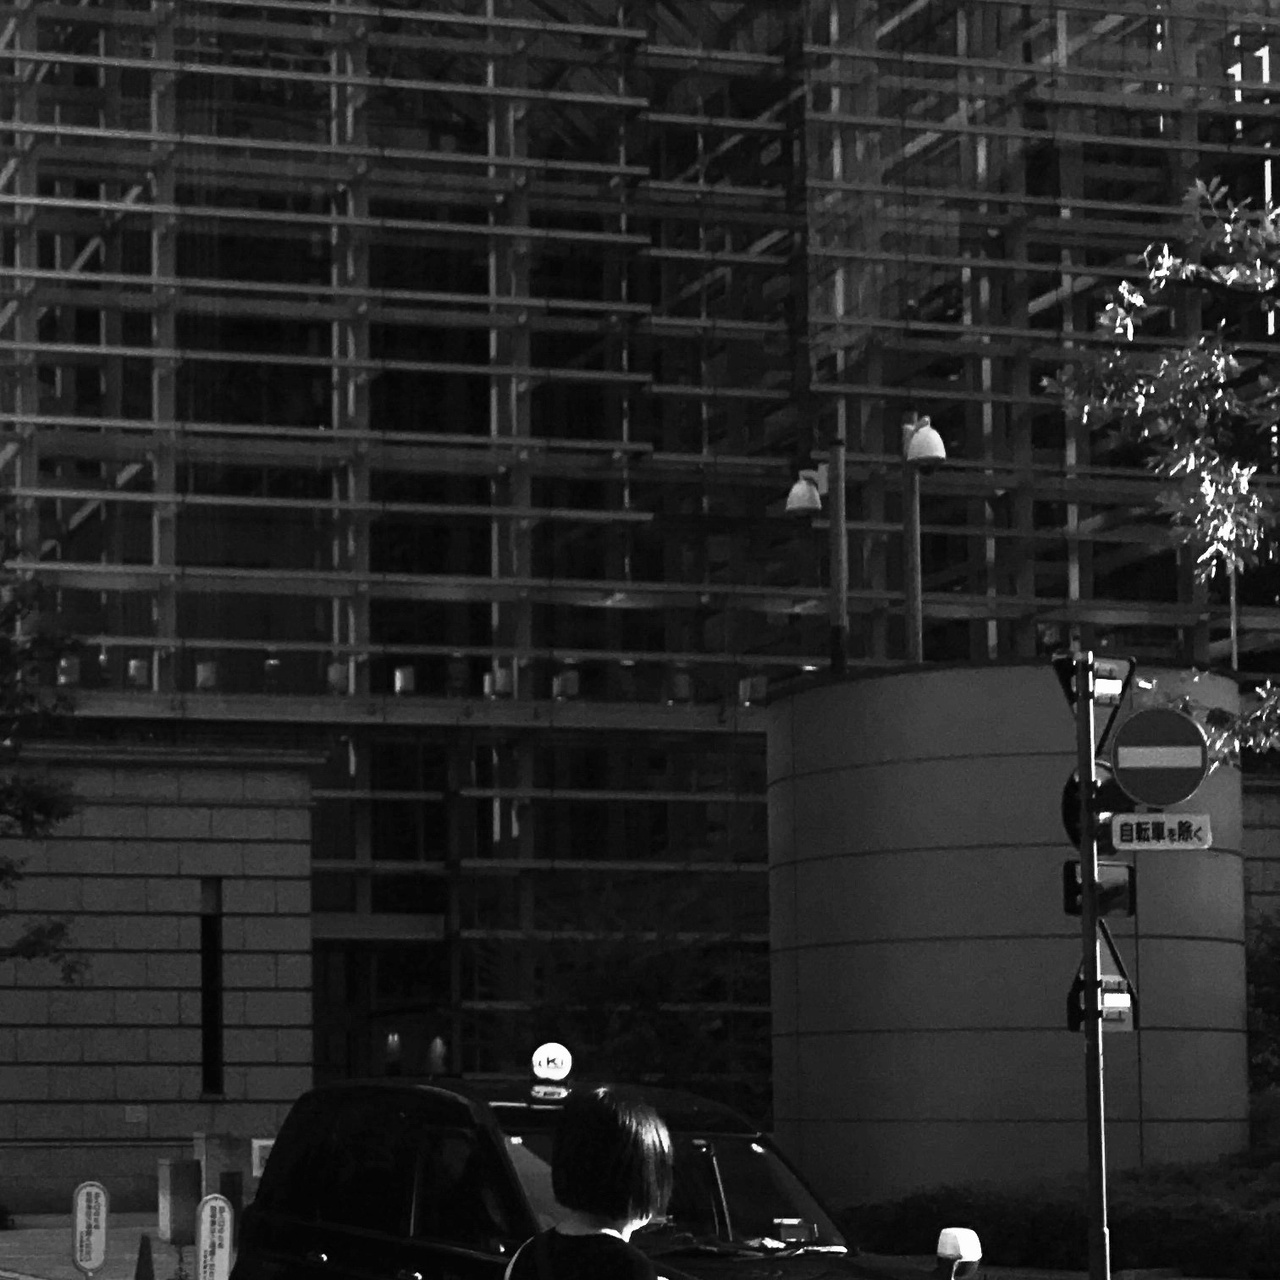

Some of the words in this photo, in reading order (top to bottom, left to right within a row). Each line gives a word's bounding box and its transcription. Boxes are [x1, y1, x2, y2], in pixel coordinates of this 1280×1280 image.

[1120, 820, 1202, 844] 自転車を除く
